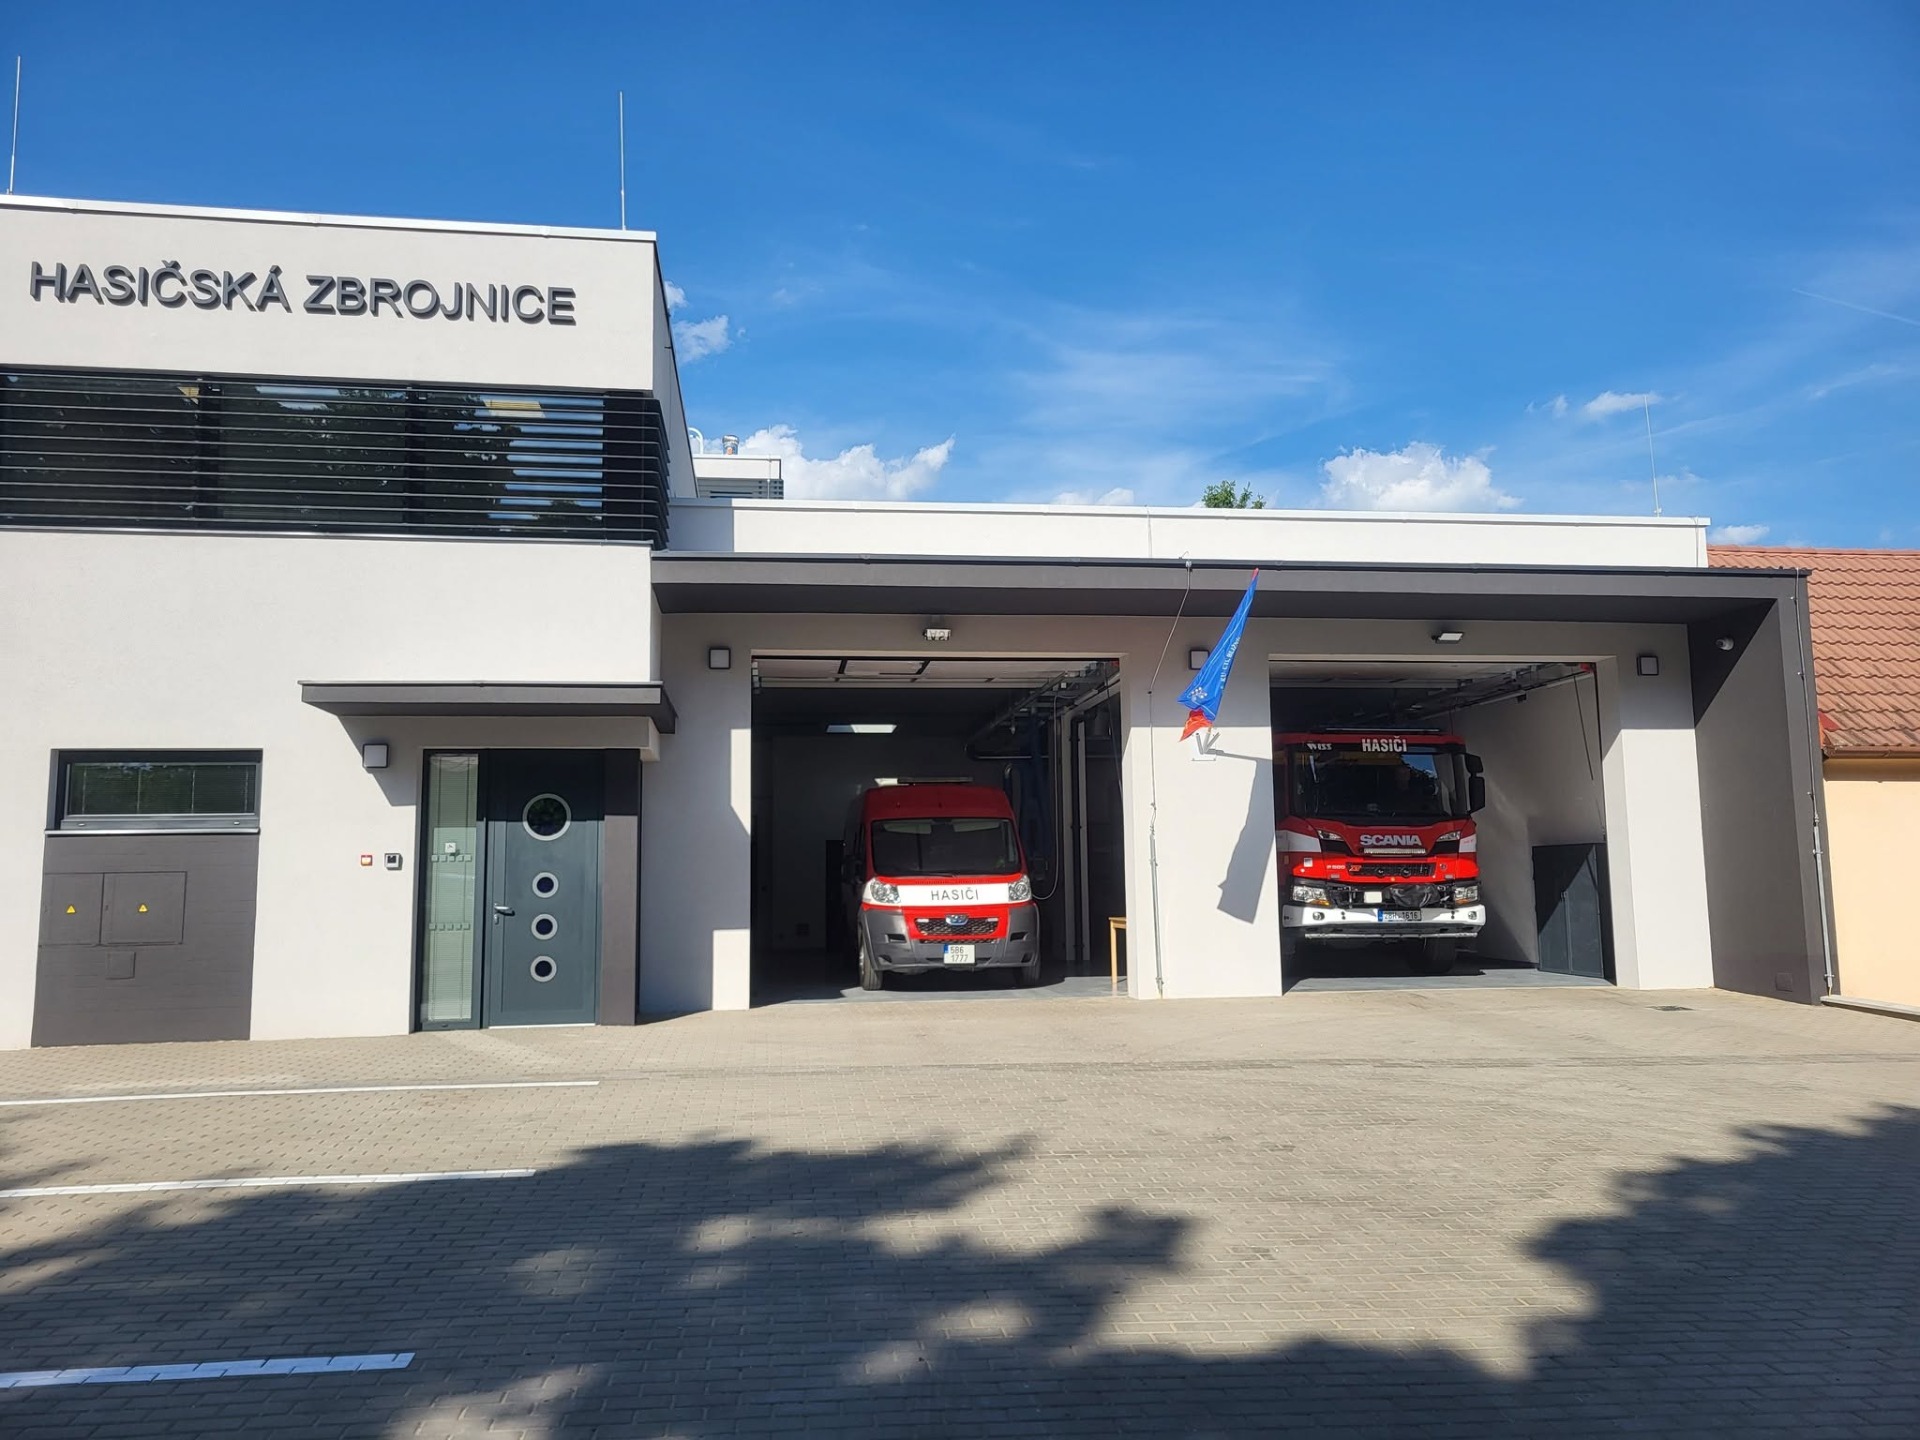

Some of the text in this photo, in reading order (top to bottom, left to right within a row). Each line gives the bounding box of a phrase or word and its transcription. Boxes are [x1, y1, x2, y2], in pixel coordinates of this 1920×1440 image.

[30, 260, 576, 325] HASIČSKÁ ZBROJNICE
[1361, 735, 1407, 752] HASIČI
[1360, 834, 1422, 846] SCANIA
[931, 887, 979, 901] HASIČI
